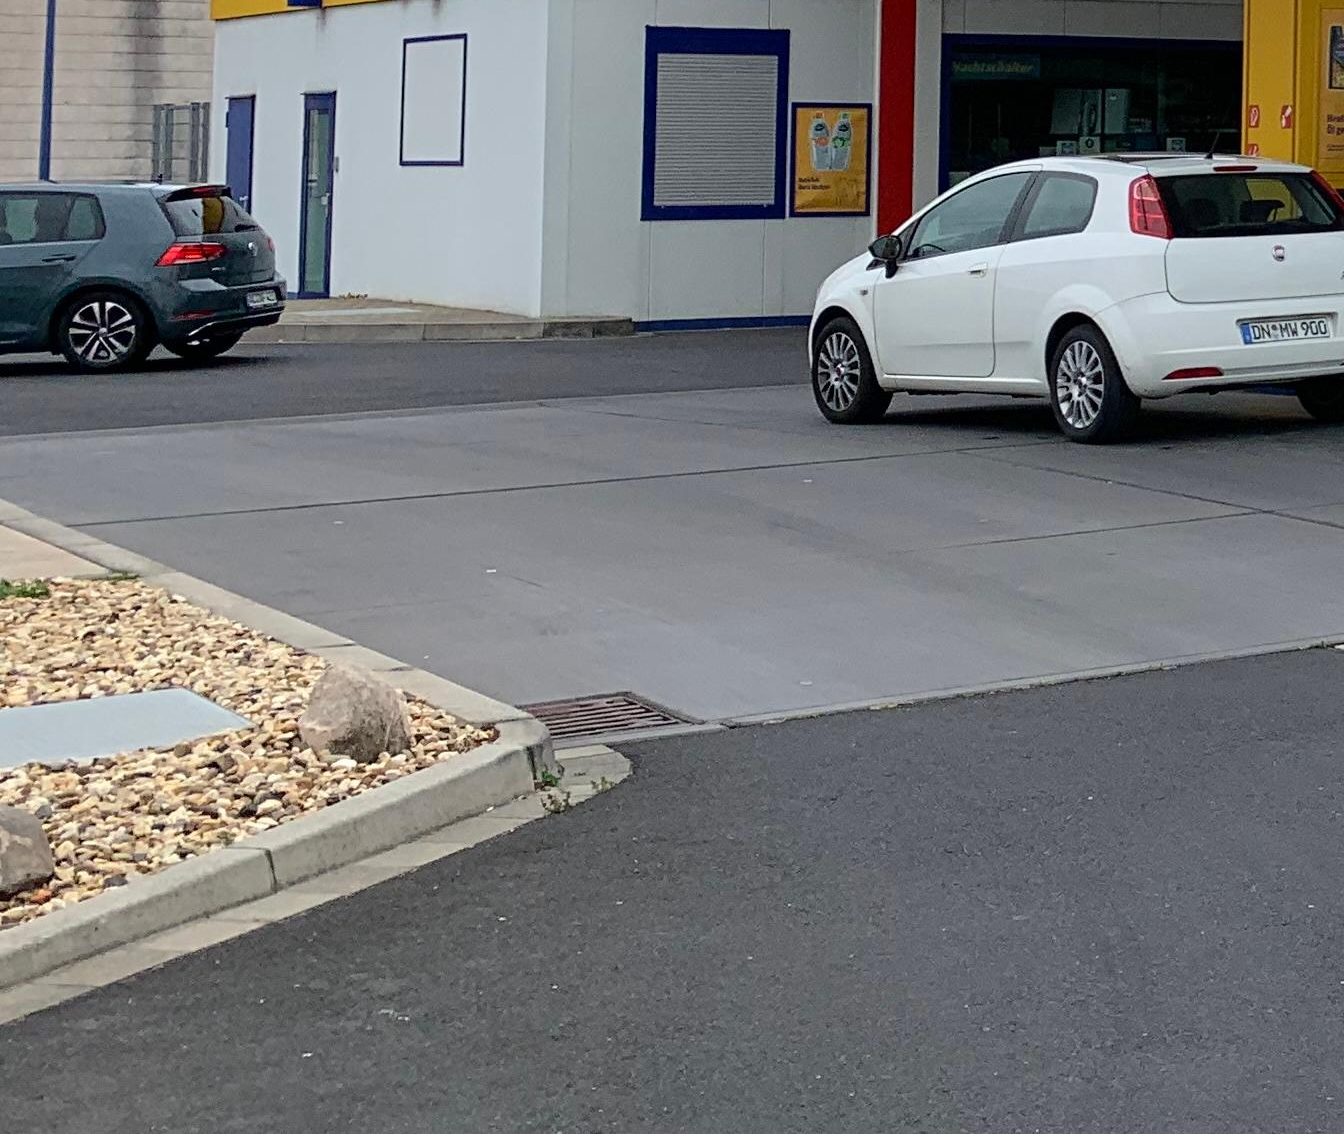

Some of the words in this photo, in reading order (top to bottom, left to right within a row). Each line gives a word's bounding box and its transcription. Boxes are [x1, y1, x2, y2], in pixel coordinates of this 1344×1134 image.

[1251, 323, 1271, 341] DN
[1280, 322, 1298, 337] MW
[1300, 320, 1328, 336] 900
